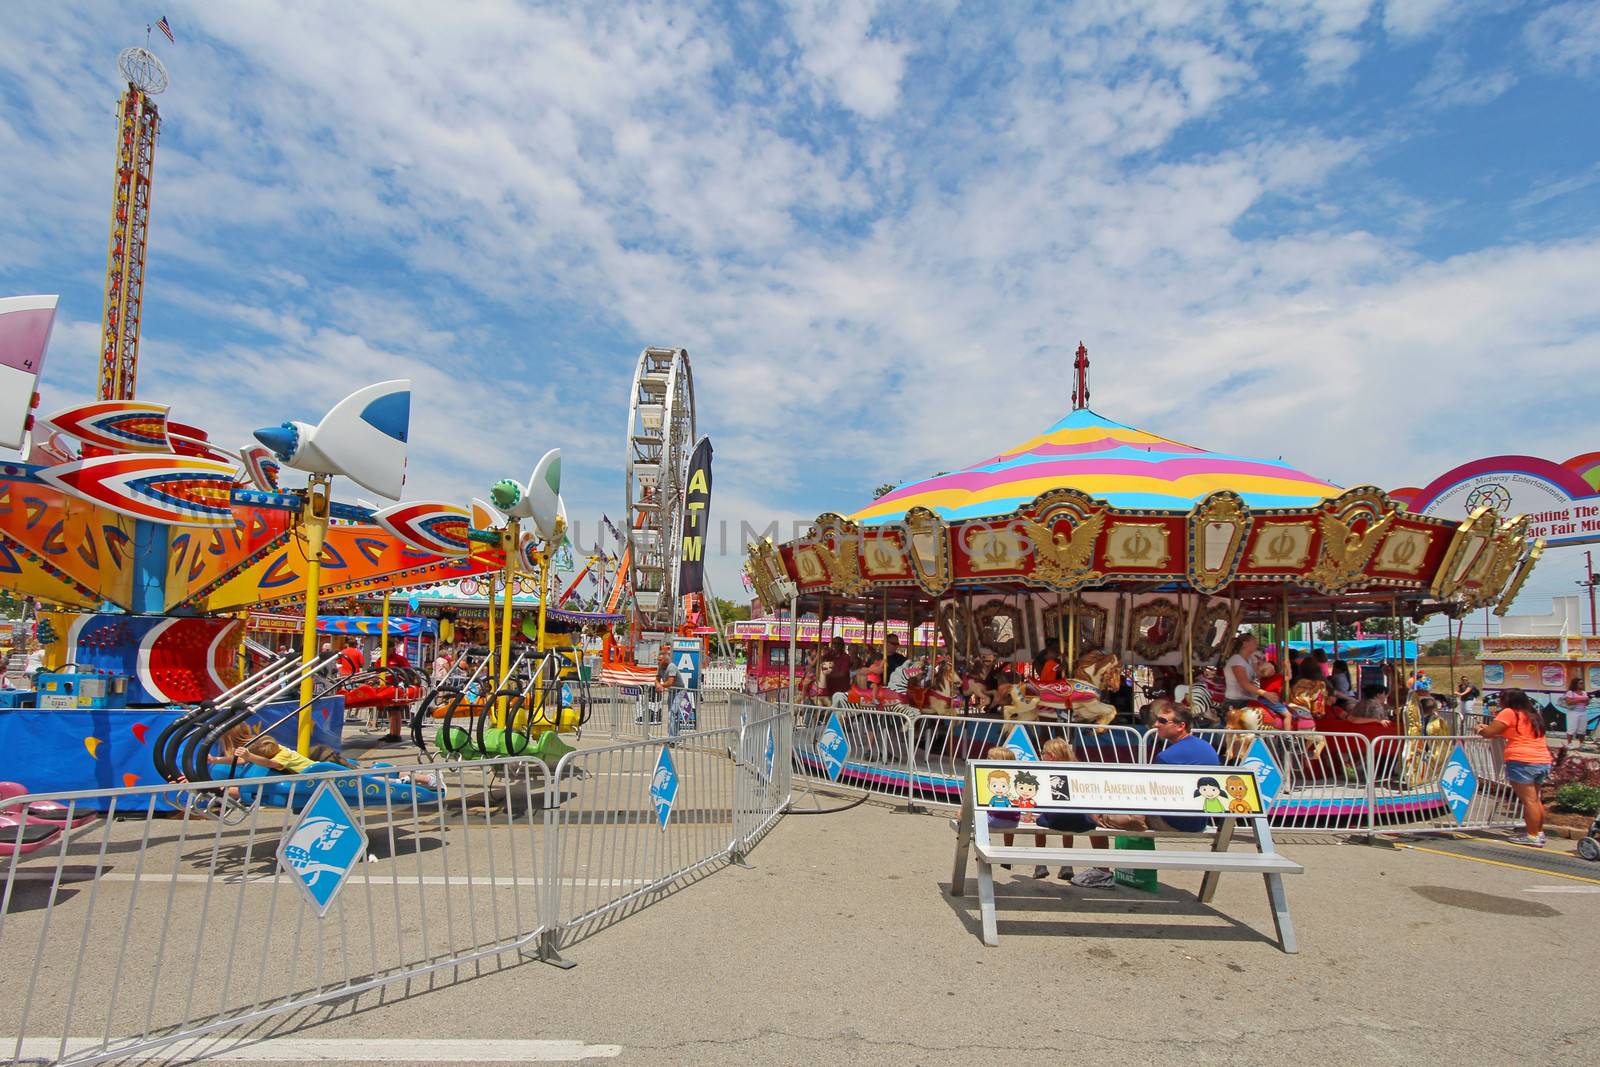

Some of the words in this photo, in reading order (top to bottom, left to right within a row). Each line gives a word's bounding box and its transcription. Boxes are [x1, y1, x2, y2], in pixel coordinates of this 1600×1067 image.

[24, 359, 33, 369] 4
[1475, 474, 1510, 485] Midway
[1512, 474, 1567, 504] Entertainment
[682, 469, 708, 562] ATM
[1530, 508, 1570, 524] isiting
[1573, 505, 1599, 518] The
[1527, 525, 1547, 538] ate
[1551, 522, 1577, 536] Fair
[458, 609, 482, 618] CHOICE
[624, 687, 639, 695] EXIT
[1071, 778, 1100, 794] NORTH
[1103, 780, 1146, 796] AMERICAN
[1149, 781, 1184, 797] MIDWAY
